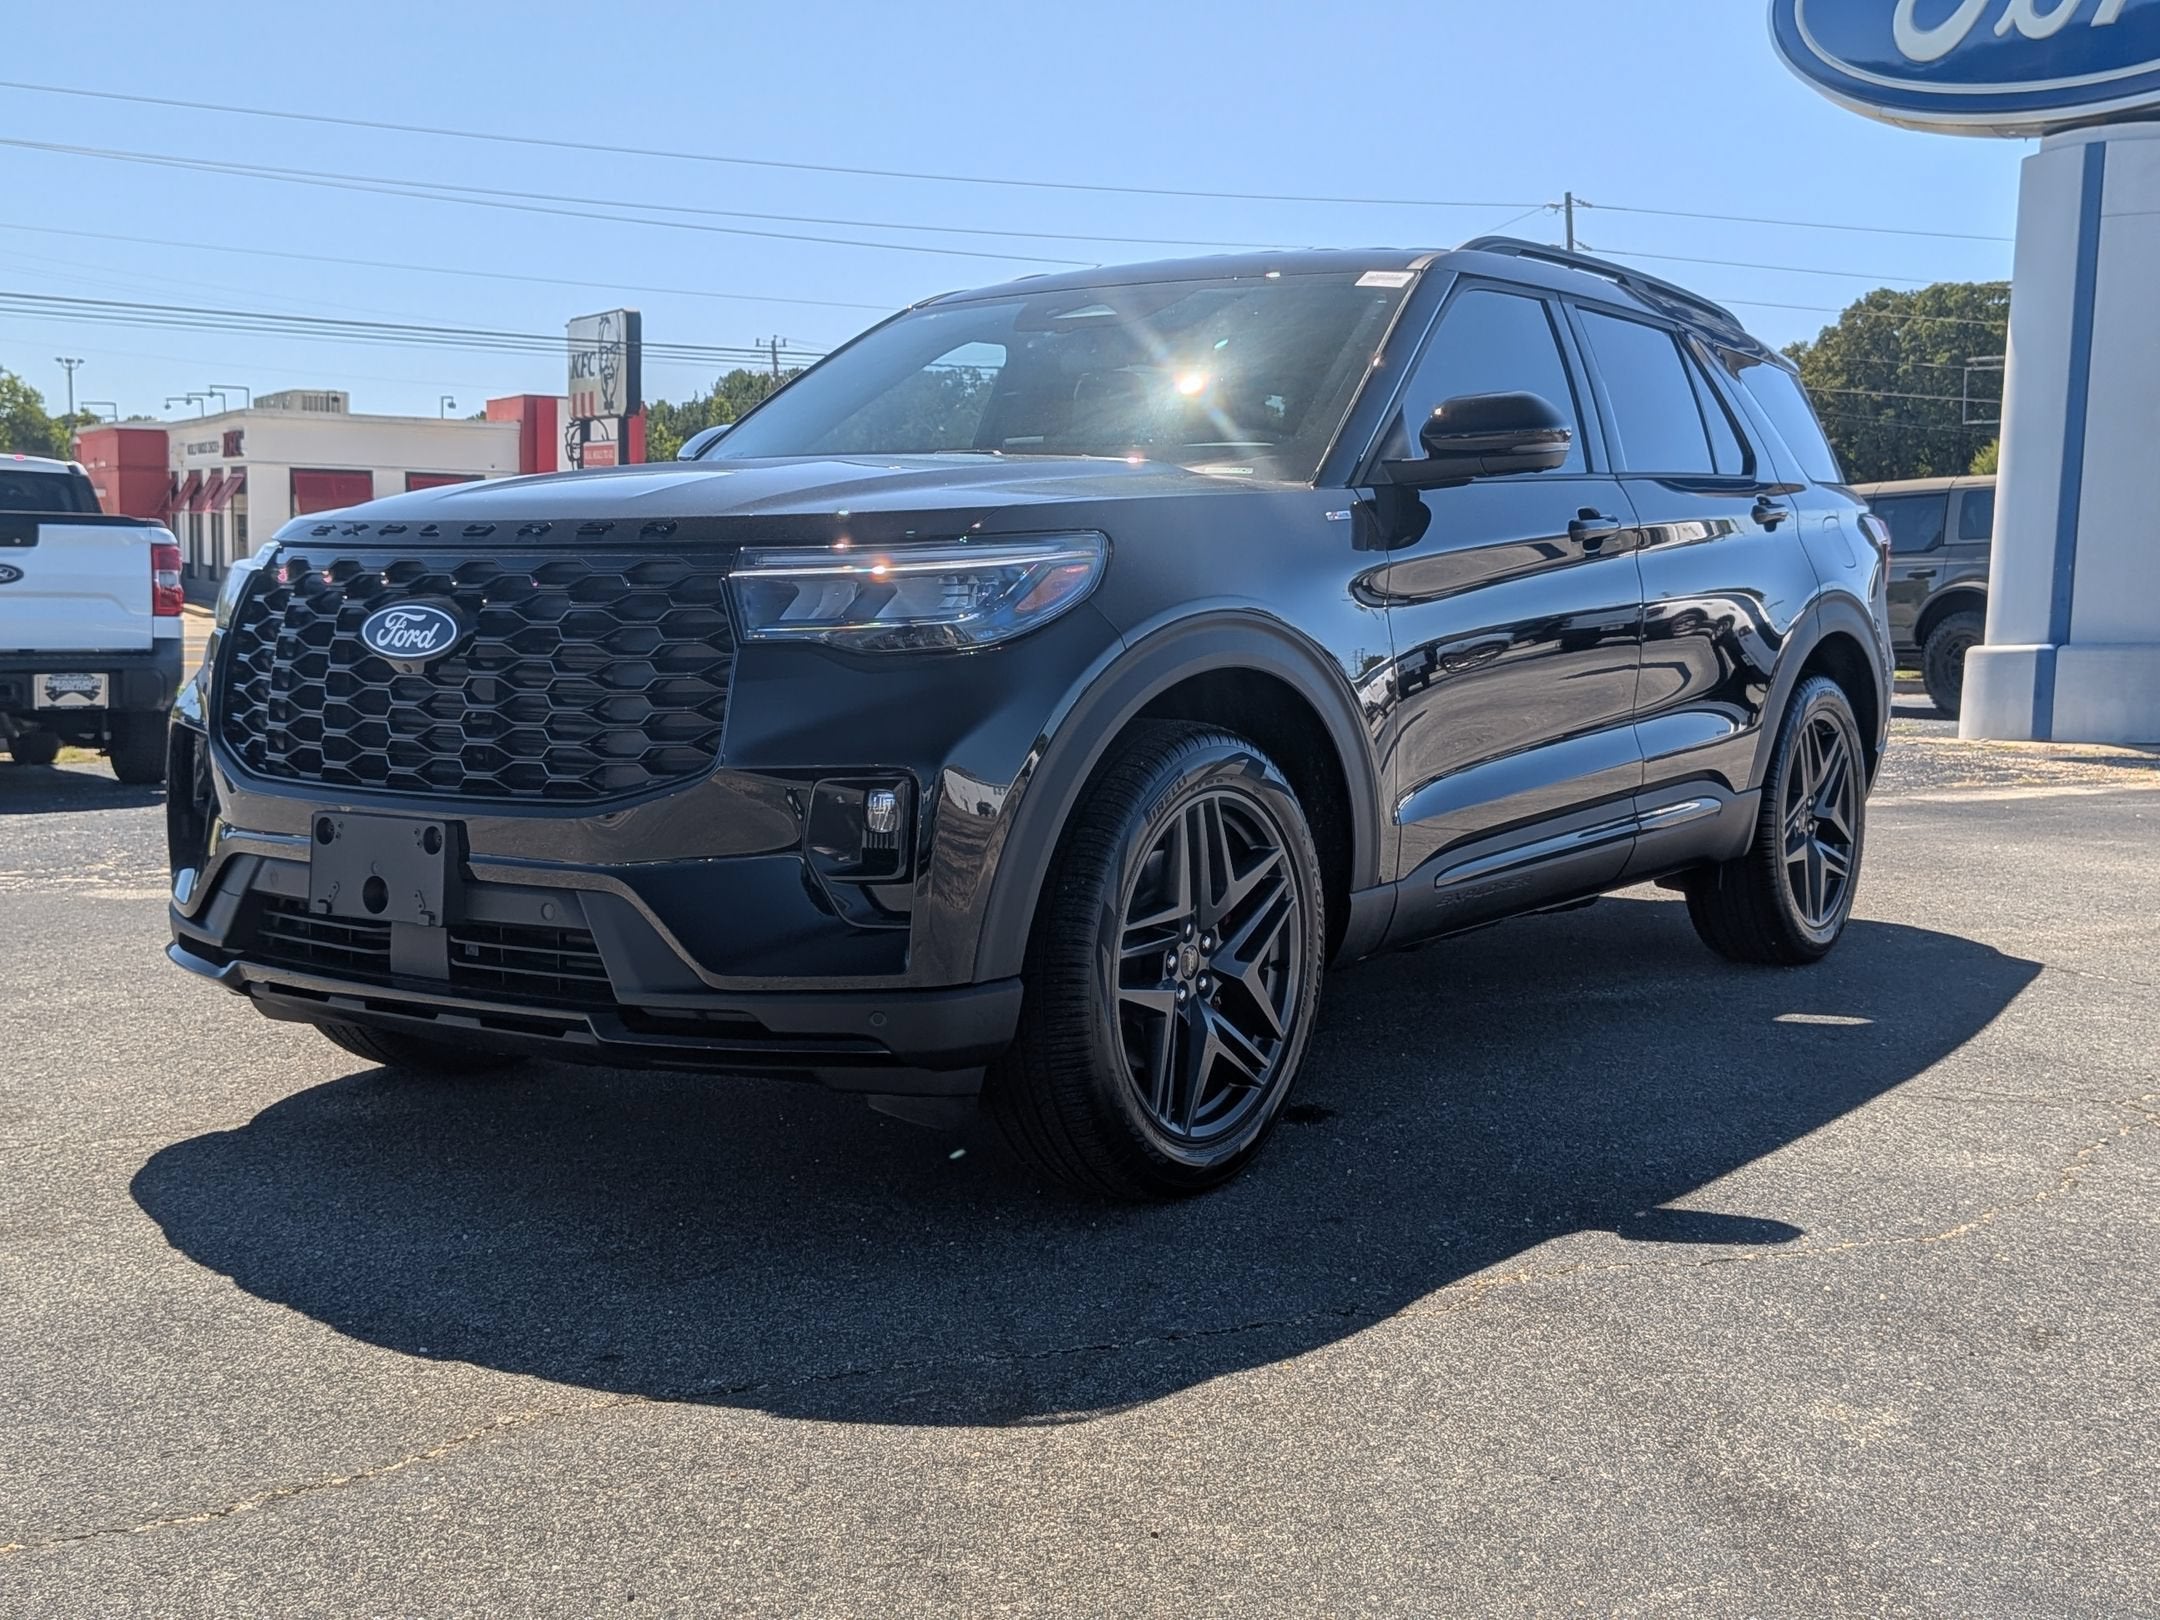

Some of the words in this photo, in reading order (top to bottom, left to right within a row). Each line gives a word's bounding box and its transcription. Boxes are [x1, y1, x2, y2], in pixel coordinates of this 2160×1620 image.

[571, 352, 595, 379] KFC
[376, 612, 441, 649] Ford
[1143, 768, 1188, 826] PIRELLI
